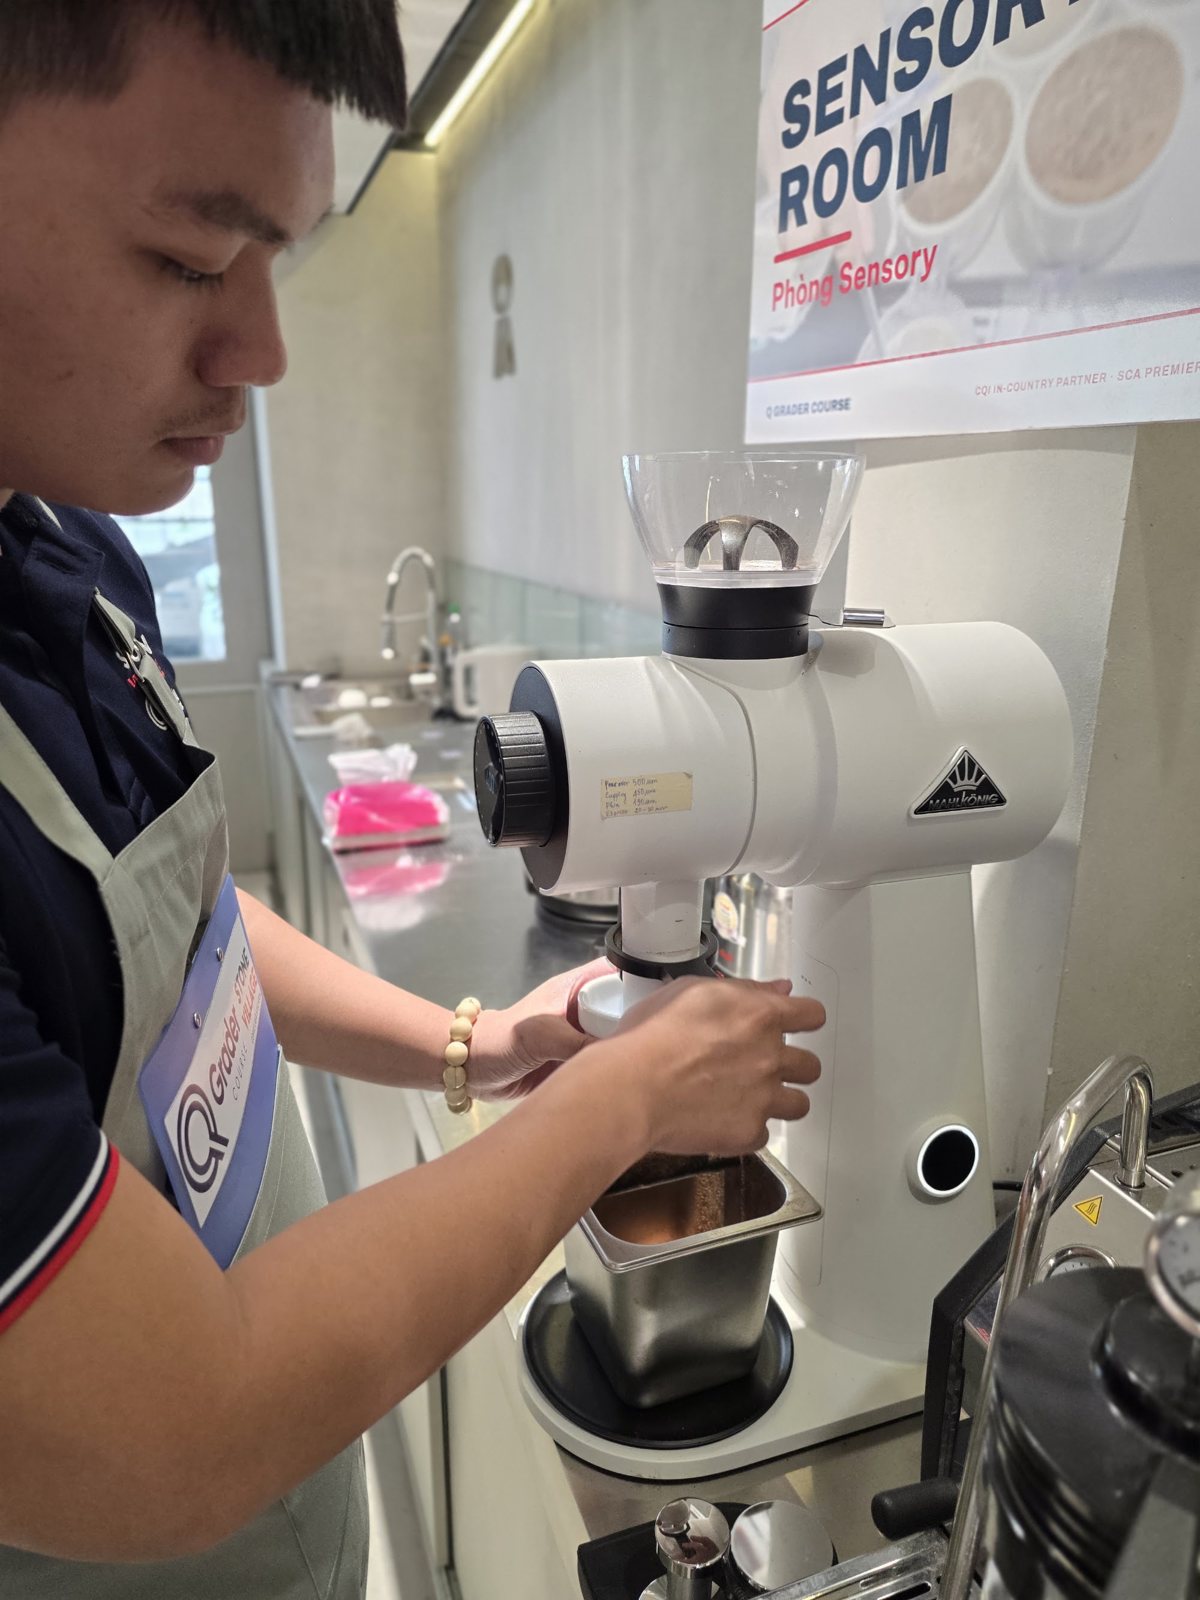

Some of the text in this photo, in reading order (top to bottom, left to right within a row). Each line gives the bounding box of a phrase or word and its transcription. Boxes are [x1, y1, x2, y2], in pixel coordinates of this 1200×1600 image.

[781, 0, 1079, 149] SENSO
[778, 93, 952, 234] ROOM
[772, 244, 938, 312] Phòng Sensory
[773, 402, 809, 417] GRADER
[811, 397, 851, 414] COURSE
[975, 361, 1200, 396] CQI IN-COUNTRY PARTNER SCA PREMIER
[234, 946, 249, 1004] STONE
[209, 1006, 241, 1106] Grader
[232, 1041, 248, 1101] COURSE
